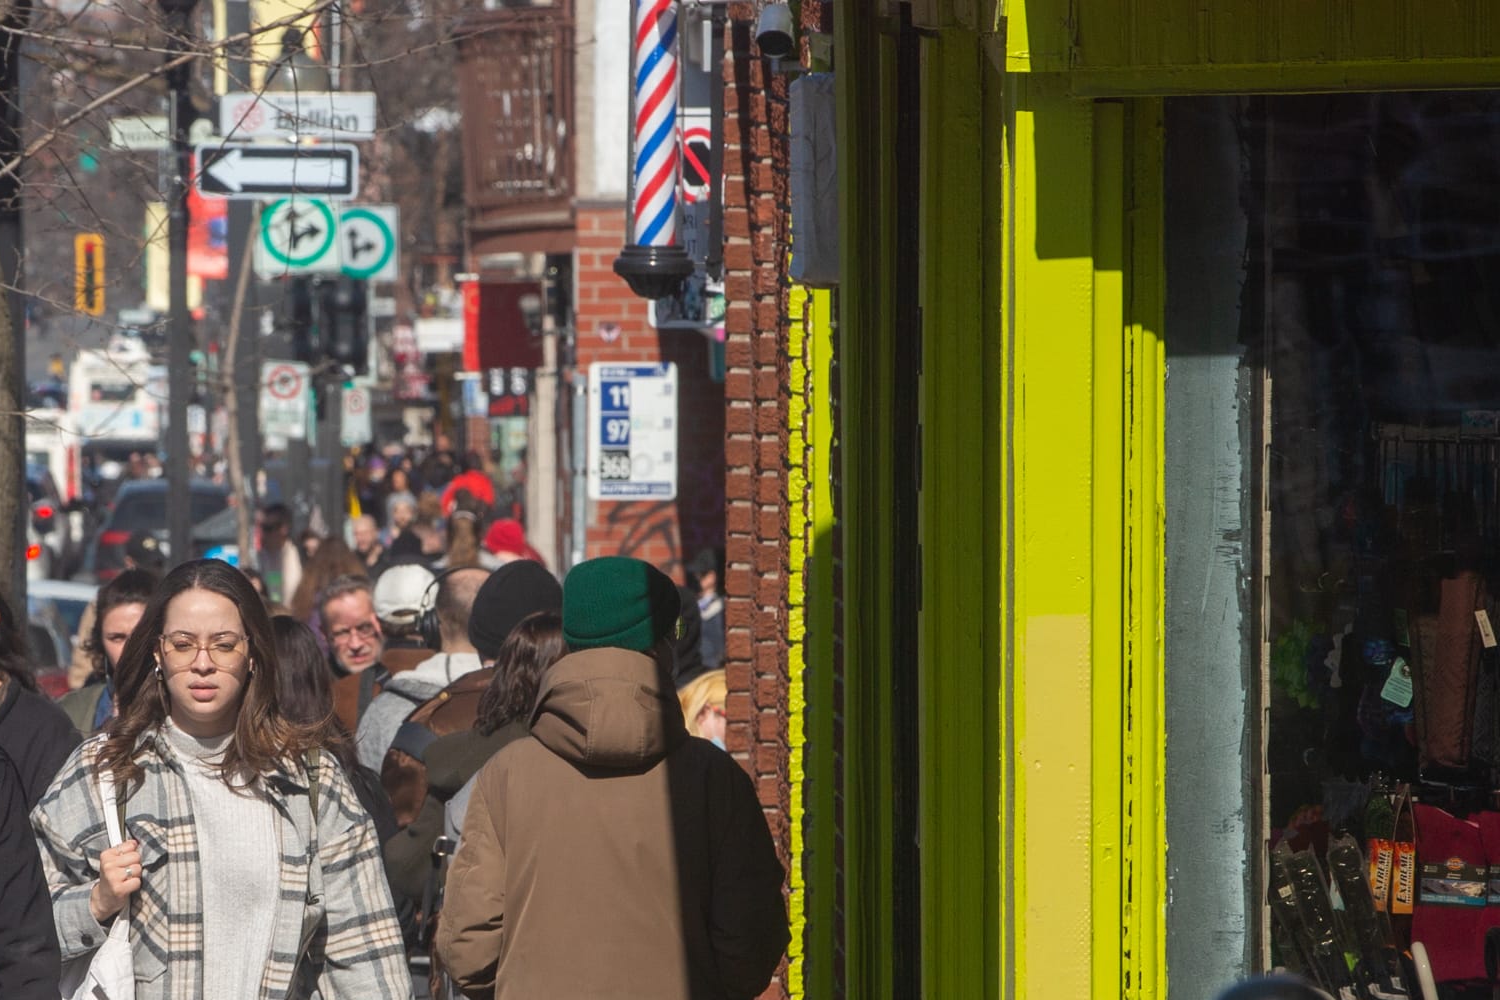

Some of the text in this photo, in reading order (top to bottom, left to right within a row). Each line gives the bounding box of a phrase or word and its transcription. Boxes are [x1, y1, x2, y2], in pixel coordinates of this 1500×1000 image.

[609, 385, 629, 408] 11
[606, 419, 630, 443] 97
[1397, 855, 1408, 904] EXTREME
